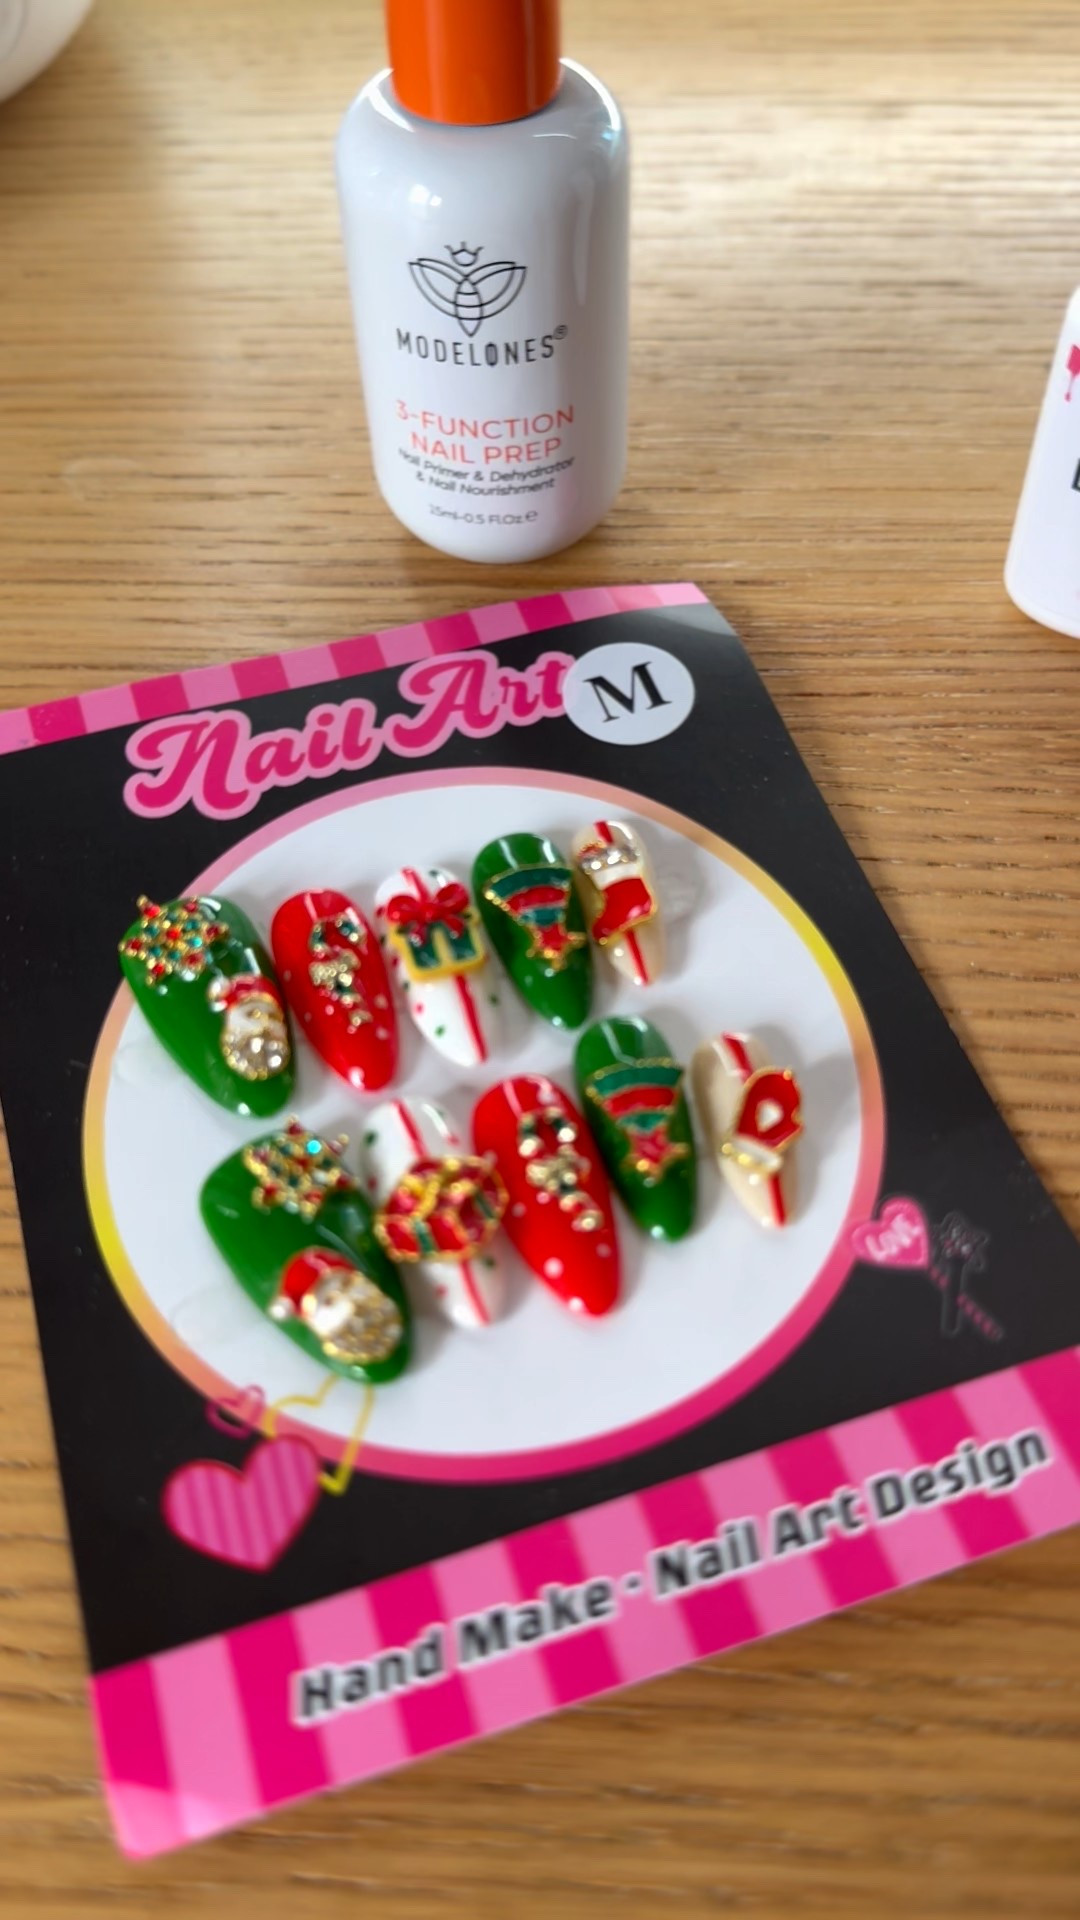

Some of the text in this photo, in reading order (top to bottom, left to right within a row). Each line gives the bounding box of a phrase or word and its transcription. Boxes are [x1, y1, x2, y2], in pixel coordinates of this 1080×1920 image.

[396, 400, 574, 439] 3-FUNCTION
[399, 447, 575, 484] Nail Primer & Dehydrator
[411, 432, 562, 464] NAIL PREP
[416, 471, 556, 496] & Nail Nourishment
[583, 660, 673, 724] M
[130, 657, 568, 814] Nail Art
[299, 1625, 444, 1719] Hand
[458, 1577, 614, 1665] Make
[653, 1519, 761, 1596] Nail
[772, 1491, 863, 1556] Art
[870, 1430, 1050, 1519] Design
